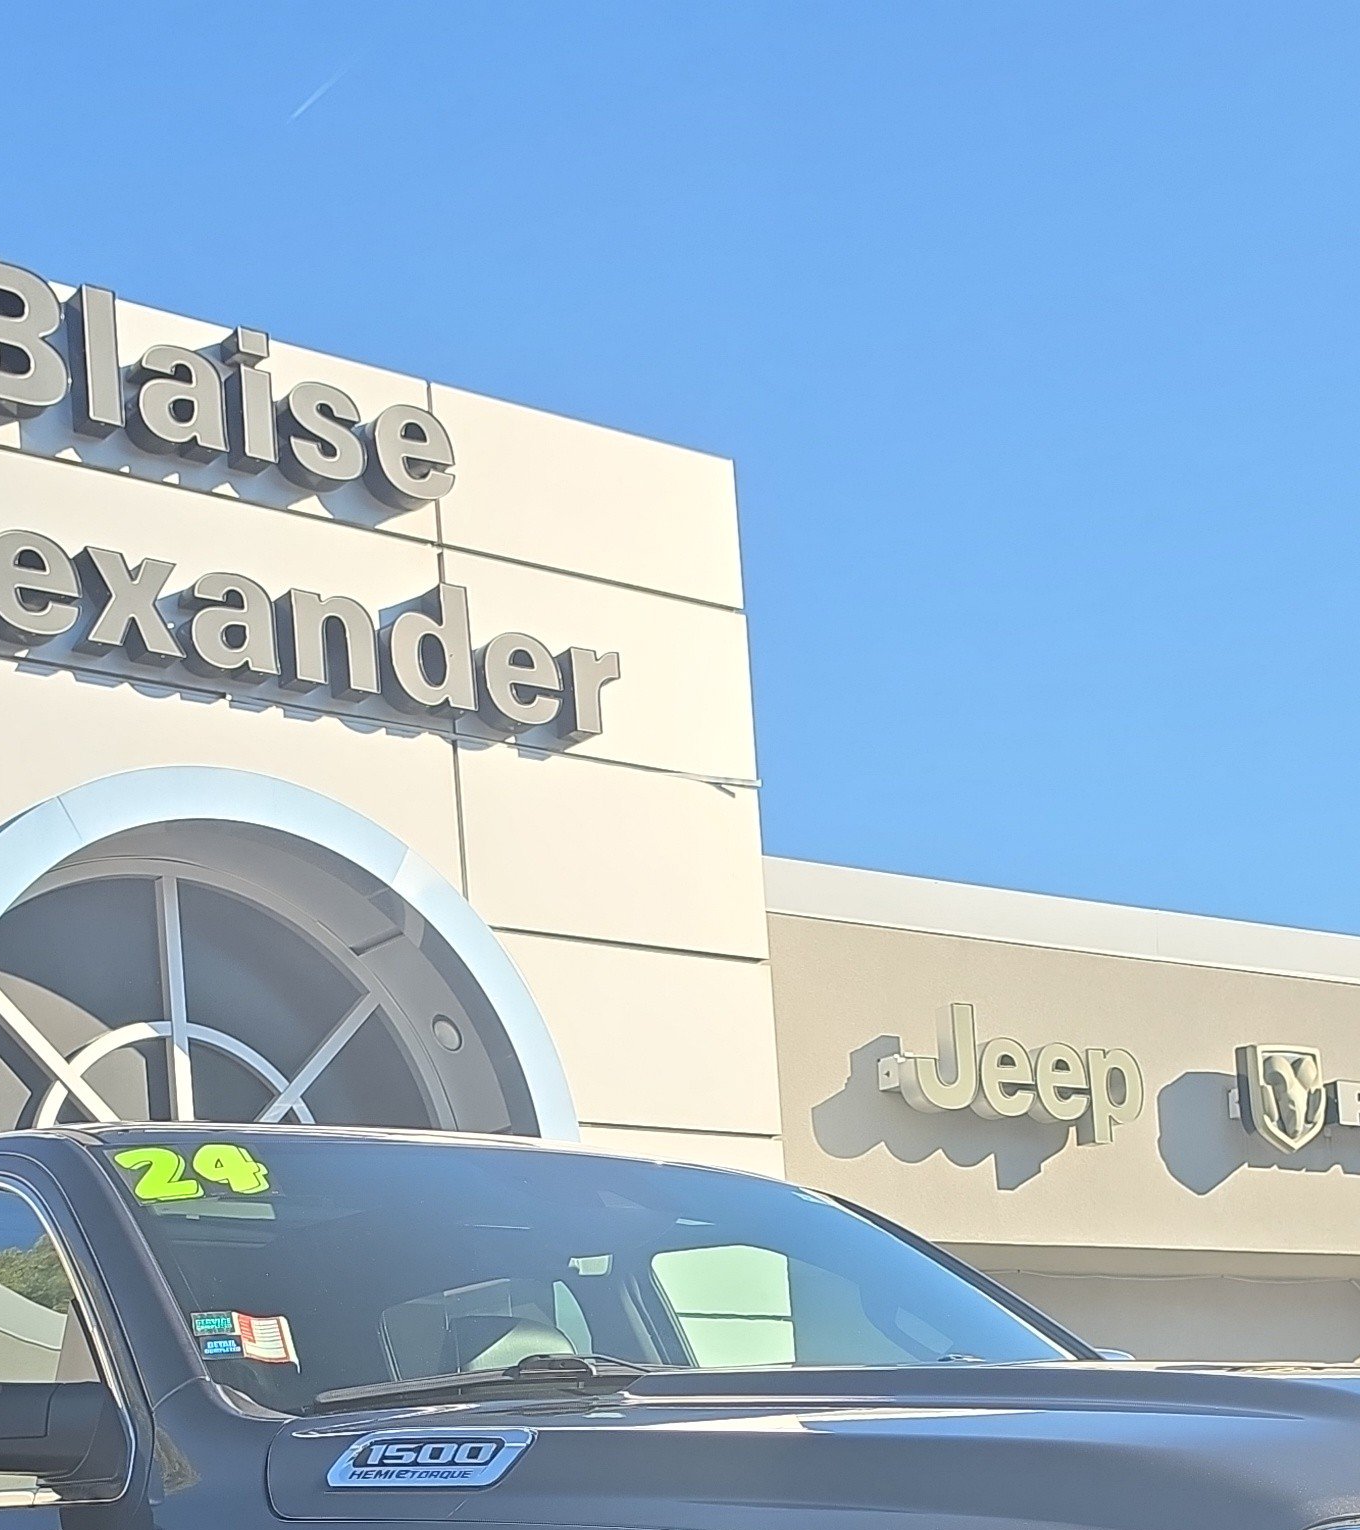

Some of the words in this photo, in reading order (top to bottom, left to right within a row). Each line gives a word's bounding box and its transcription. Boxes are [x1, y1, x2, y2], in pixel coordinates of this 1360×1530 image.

[900, 1003, 1144, 1145] Jeep
[115, 1144, 270, 1200] 24
[366, 1442, 498, 1465] 1500
